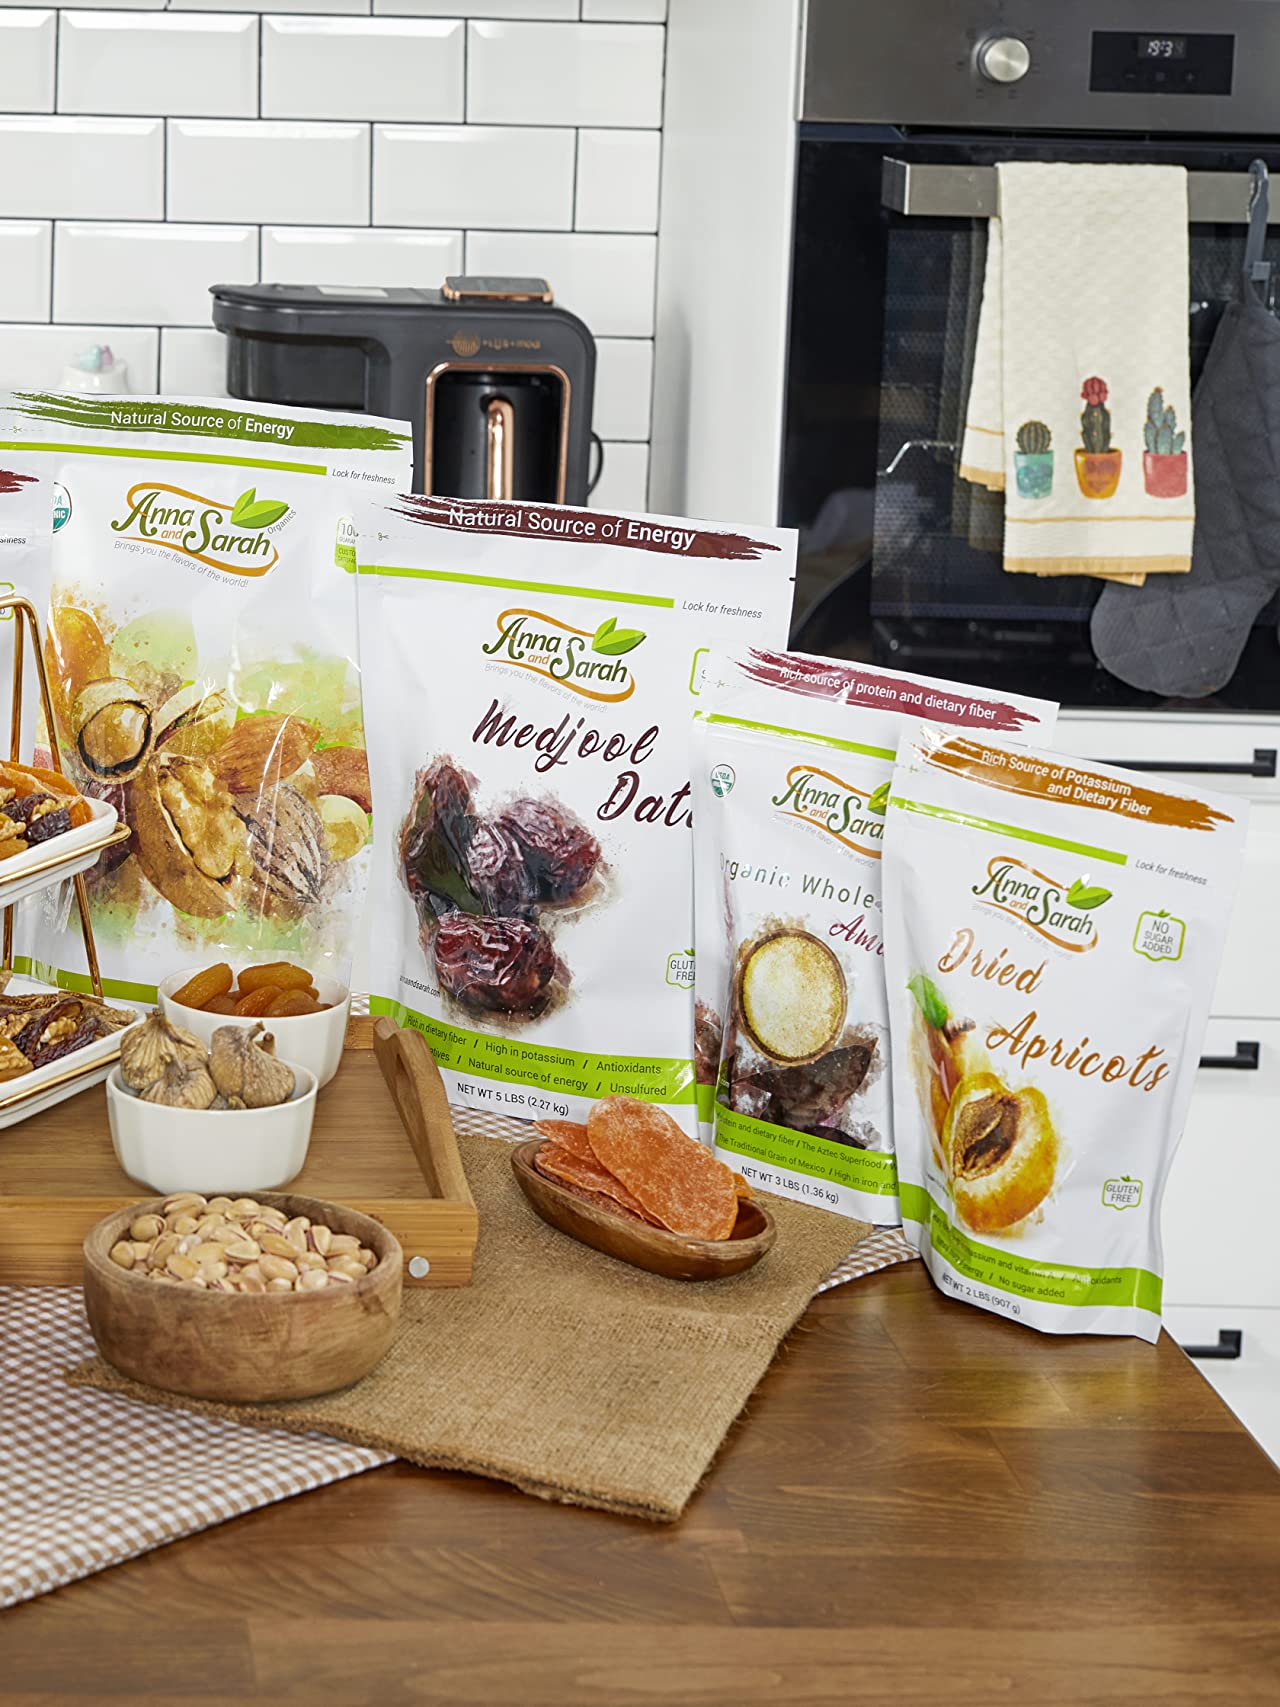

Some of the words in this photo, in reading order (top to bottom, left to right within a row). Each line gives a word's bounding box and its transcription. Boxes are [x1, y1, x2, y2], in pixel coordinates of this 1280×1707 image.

[111, 411, 166, 426] Natural
[171, 412, 224, 429] Source
[228, 416, 242, 430] of
[245, 418, 294, 440] Energy
[332, 468, 349, 479] Lock
[350, 470, 361, 481] for
[362, 471, 395, 485] freshness
[111, 492, 194, 534] Anna
[183, 509, 270, 557] Sarah
[161, 528, 183, 541] and
[266, 508, 297, 536] Organics
[449, 509, 521, 528] Natural
[527, 512, 596, 536] Source
[601, 519, 624, 538] of
[627, 521, 695, 551] Energy
[114, 541, 139, 554] Brings
[141, 545, 156, 559] you
[158, 549, 170, 561] the
[171, 552, 196, 571] flavors
[197, 564, 207, 575] of
[208, 568, 220, 581] the
[222, 575, 249, 588] world!
[682, 600, 704, 613] Lock
[705, 602, 718, 614] for
[719, 605, 762, 620] freshness
[483, 617, 560, 658] Anna
[550, 637, 627, 684] Sarah
[527, 652, 550, 665] and
[779, 666, 802, 680] Rich
[803, 671, 840, 689] source
[842, 679, 855, 692] of
[856, 679, 897, 701] protein
[899, 687, 922, 704] and
[925, 689, 966, 717] dietary
[969, 703, 997, 720] fiber
[472, 699, 659, 772] Medjool
[982, 750, 1006, 766] Rich
[1008, 756, 1048, 777] Source
[1050, 767, 1064, 780] of
[1066, 770, 1132, 796] Potassium
[597, 771, 693, 828] Dat
[1047, 781, 1072, 795] and
[1073, 785, 1117, 810] Dietary
[1120, 798, 1152, 816] Fiber
[802, 874, 875, 909] Whole
[972, 865, 1040, 902] Anna
[1027, 889, 1093, 936] Sarah
[1009, 898, 1028, 910] and
[1144, 931, 1173, 946] SUGAR
[1152, 920, 1169, 934] NO
[938, 928, 1048, 994] Dried
[1142, 940, 1172, 954] ADDED
[486, 1041, 507, 1057] High
[510, 1045, 519, 1056] in
[521, 1050, 575, 1067] potassium
[596, 1060, 661, 1075] Antioxidants
[985, 1010, 1170, 1092] Apricots
[468, 1057, 502, 1073] Natural
[505, 1067, 538, 1082] source
[540, 1072, 551, 1084] of
[554, 1075, 588, 1092] energy
[610, 1082, 667, 1096] Unsulfured
[457, 1082, 475, 1095] NET
[477, 1087, 493, 1098] WT
[496, 1091, 502, 1101] 5
[504, 1091, 525, 1105] LBS
[527, 1095, 550, 1111] (2.27
[553, 1103, 569, 1116] kg)
[730, 1137, 766, 1158] Traditional
[768, 1150, 787, 1163] Grain
[789, 1157, 796, 1165] of
[797, 1159, 825, 1173] Mexico
[802, 1141, 815, 1152] The
[817, 1146, 838, 1159] Aztec
[840, 1152, 881, 1169] Superfood
[742, 1166, 757, 1178] NET
[760, 1173, 773, 1183] WT
[775, 1175, 781, 1185] 3
[783, 1178, 799, 1191] LBS
[802, 1184, 823, 1197] (1.36
[826, 1191, 839, 1204] kg)
[1107, 1185, 1139, 1193] GLUTEN
[1111, 1194, 1131, 1202] FREE
